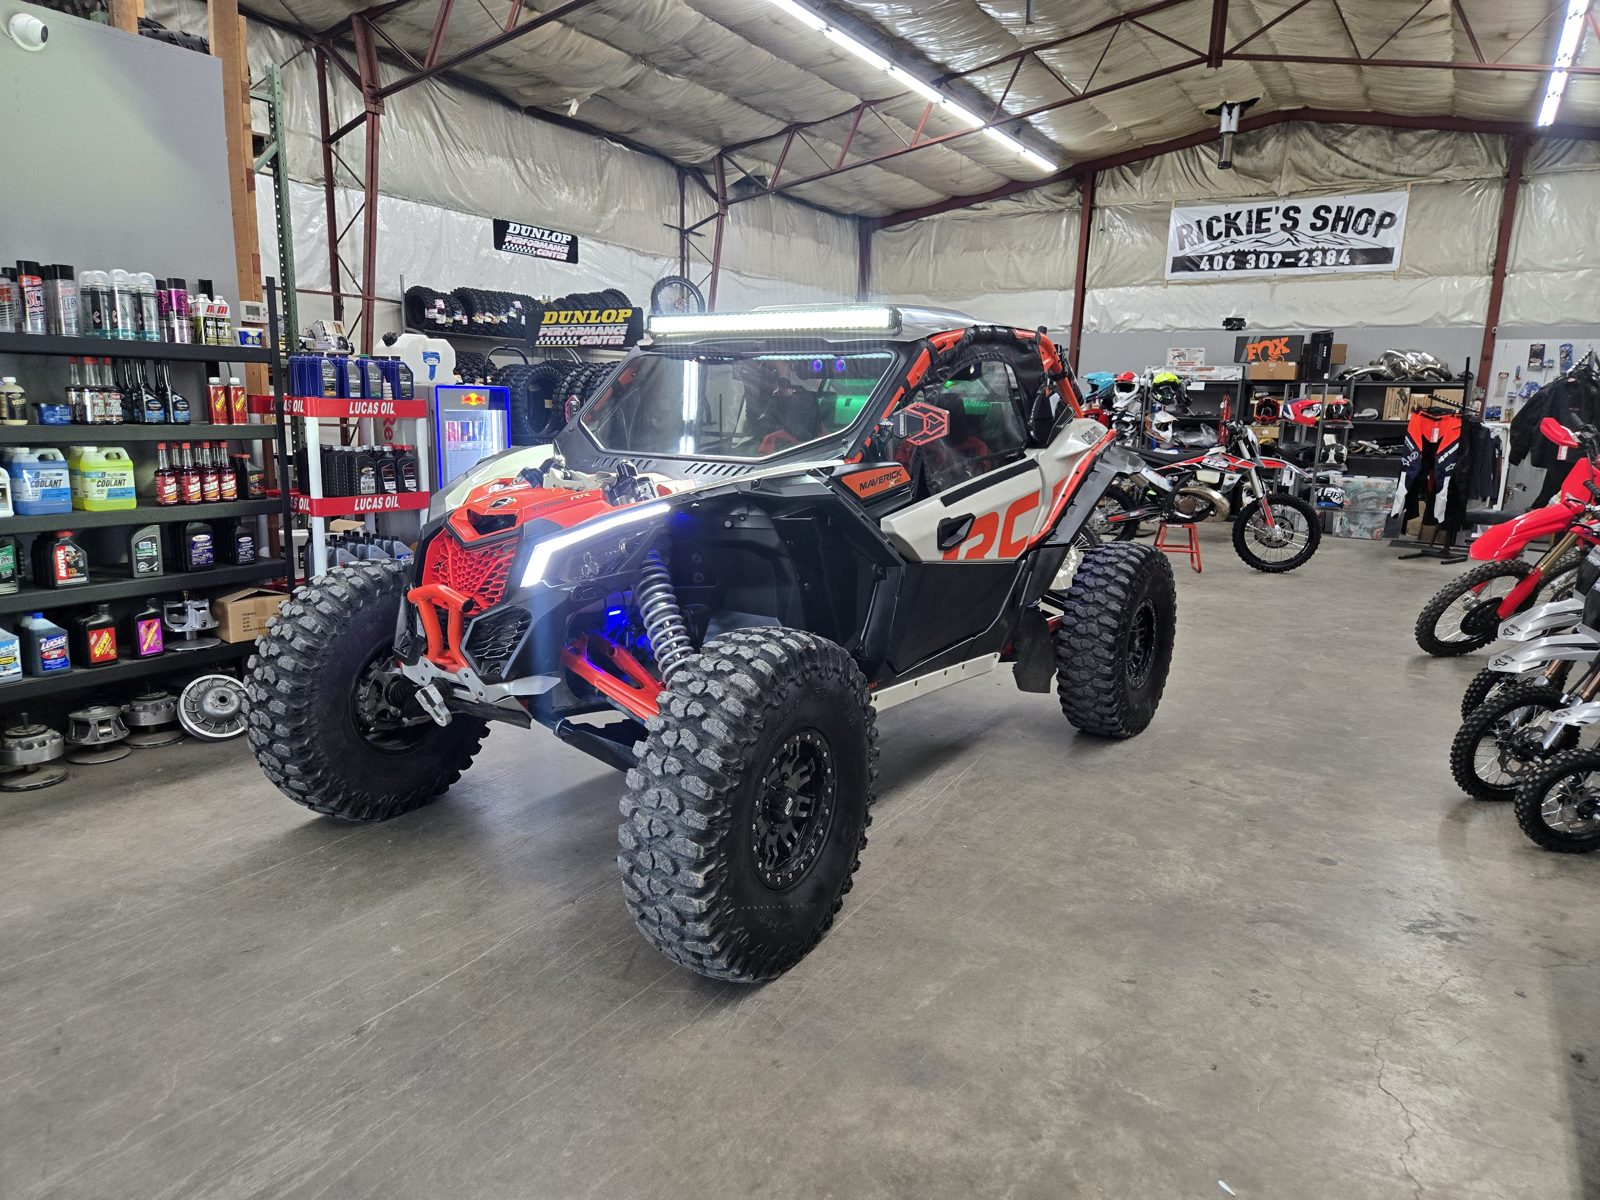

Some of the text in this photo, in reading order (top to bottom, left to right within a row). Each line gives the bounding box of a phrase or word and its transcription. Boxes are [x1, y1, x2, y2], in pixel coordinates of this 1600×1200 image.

[506, 222, 572, 244] DUNLOP
[1176, 204, 1397, 251] RICKIE'S SHOP
[504, 235, 570, 253] PERFORMANCE
[536, 248, 568, 260] CENTER
[1200, 248, 1351, 271] 406 309-2384
[541, 308, 633, 325] DUNLOP
[538, 326, 629, 337] PERFORMANCE
[580, 335, 626, 346] CENTER
[1246, 337, 1290, 362] FOX
[270, 400, 304, 412] LAS OIL
[349, 401, 395, 415] LUCAS OIL
[31, 479, 62, 488] COOLANT
[96, 479, 126, 488] COOLANT
[859, 468, 902, 492] MAVERICK
[354, 495, 399, 511] LUCAS OIL
[570, 492, 592, 501] RR
[299, 498, 310, 511] OIL
[56, 549, 67, 577] MOTUL
[41, 636, 67, 650] LUCAS
